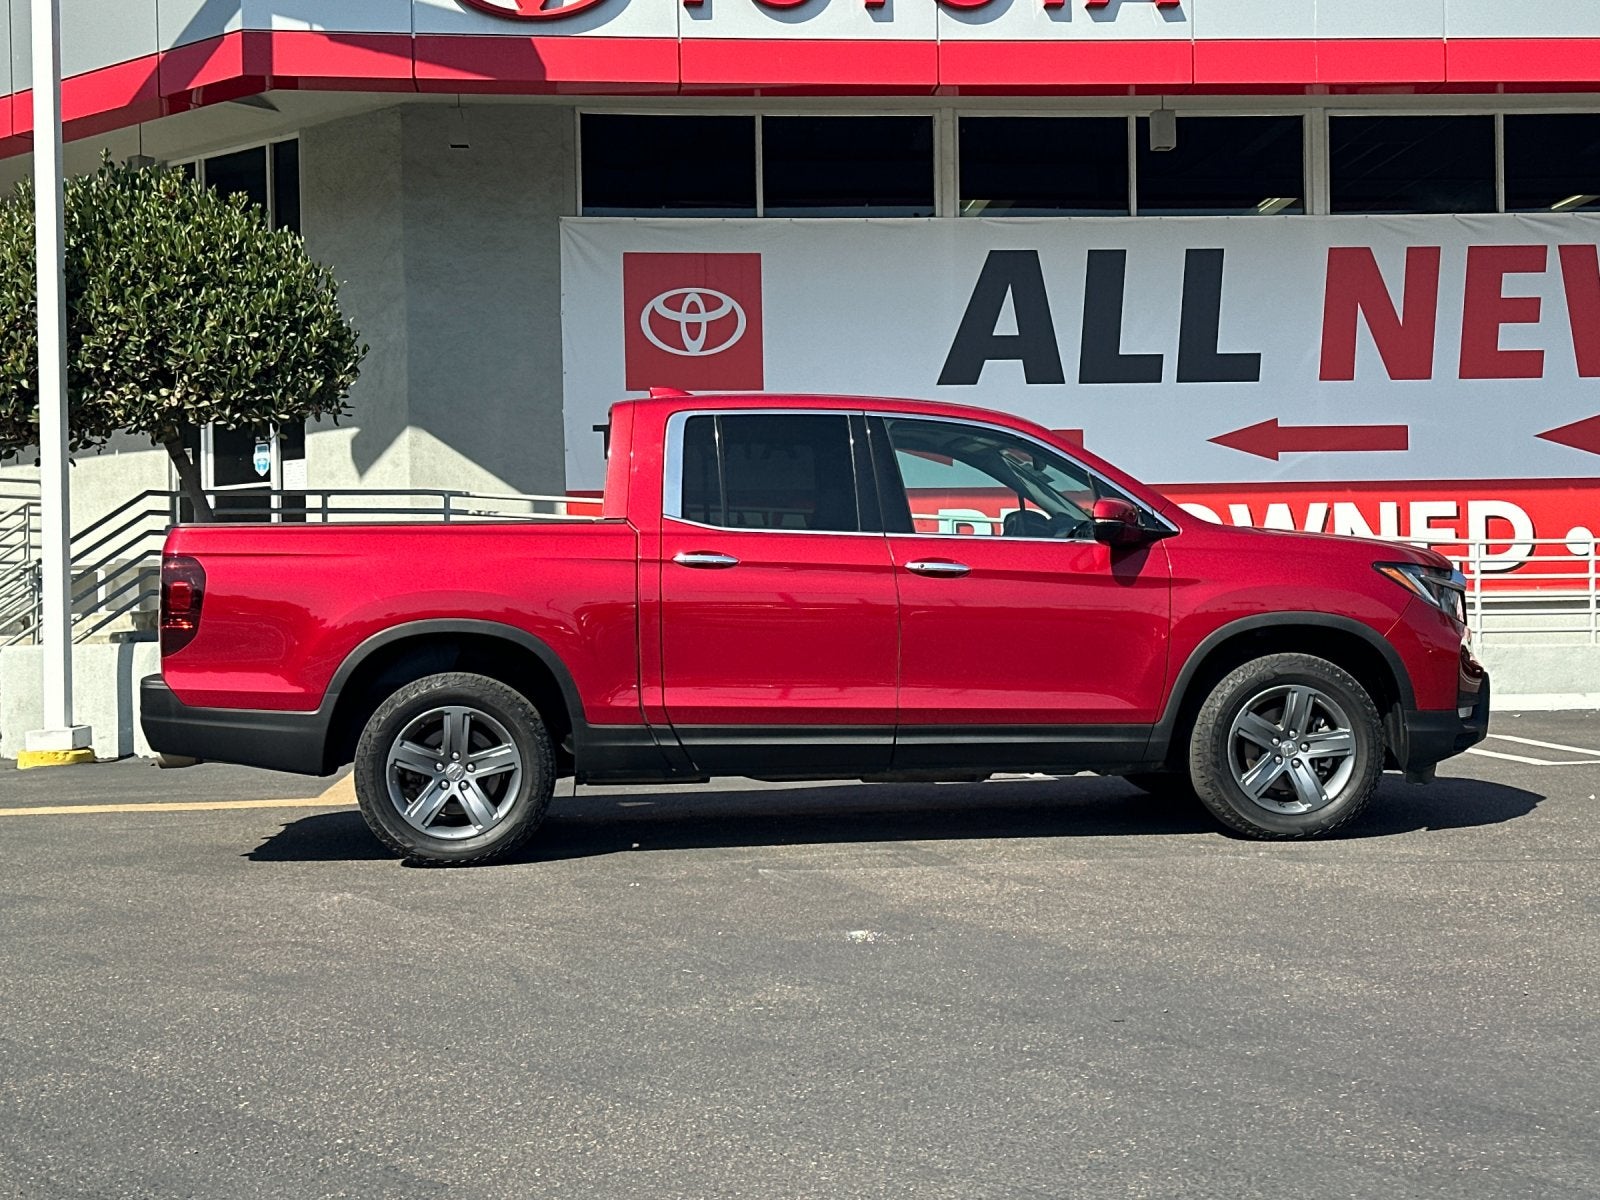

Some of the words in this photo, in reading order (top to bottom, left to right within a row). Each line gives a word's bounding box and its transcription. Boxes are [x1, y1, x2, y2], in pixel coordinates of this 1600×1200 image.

[936, 249, 1262, 385] ALL
[1319, 244, 1600, 381] NE
[1175, 499, 1536, 573] NED
